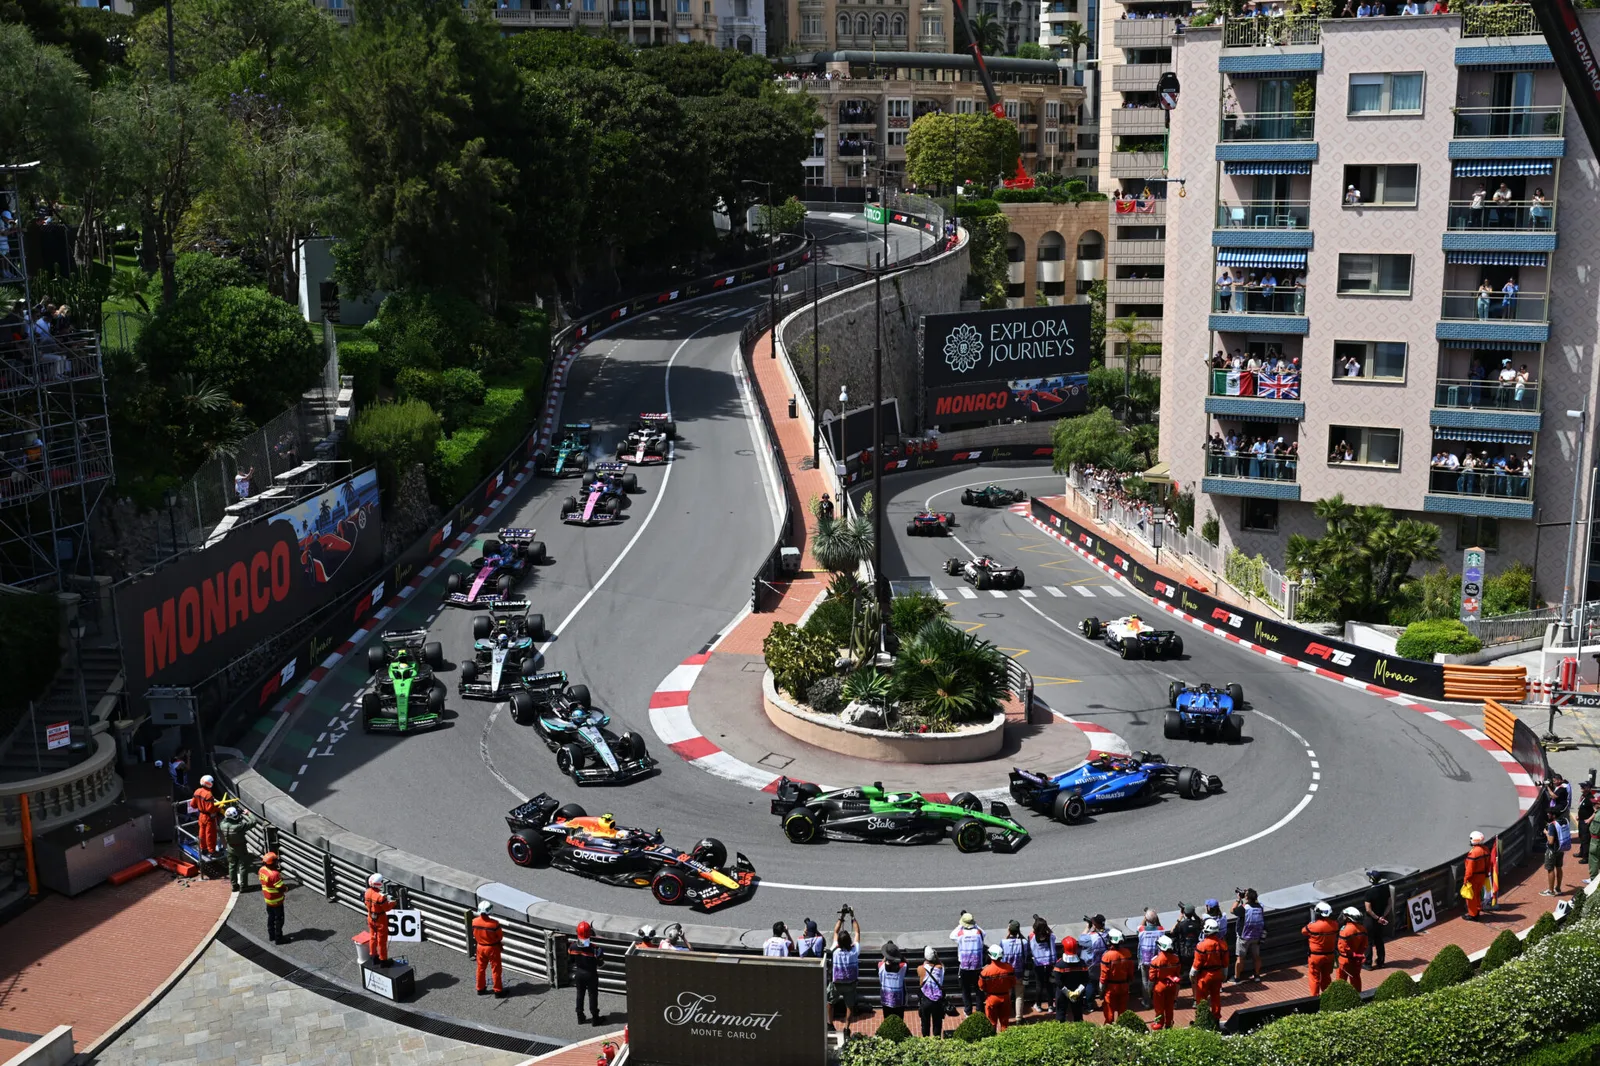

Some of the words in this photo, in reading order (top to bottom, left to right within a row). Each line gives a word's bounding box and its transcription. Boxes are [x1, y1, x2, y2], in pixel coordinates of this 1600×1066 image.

[1570, 28, 1600, 92] PIOVANO
[990, 318, 1069, 342] EXPLORA
[988, 338, 1075, 368] JOURNEYS
[935, 391, 1008, 415] MONACO
[143, 540, 290, 679] MONACO
[1255, 621, 1279, 643] Monaco
[1374, 658, 1417, 685] Monaco
[842, 788, 860, 798] Stake
[1095, 791, 1126, 801] KOMATSU
[868, 816, 896, 830] Stake
[573, 849, 618, 864] ORACLE
[1412, 898, 1433, 925] SC
[387, 914, 416, 936] SC
[663, 991, 782, 1031] Fairmont
[690, 1027, 723, 1038] MONTE
[726, 1030, 757, 1040] CARLO
